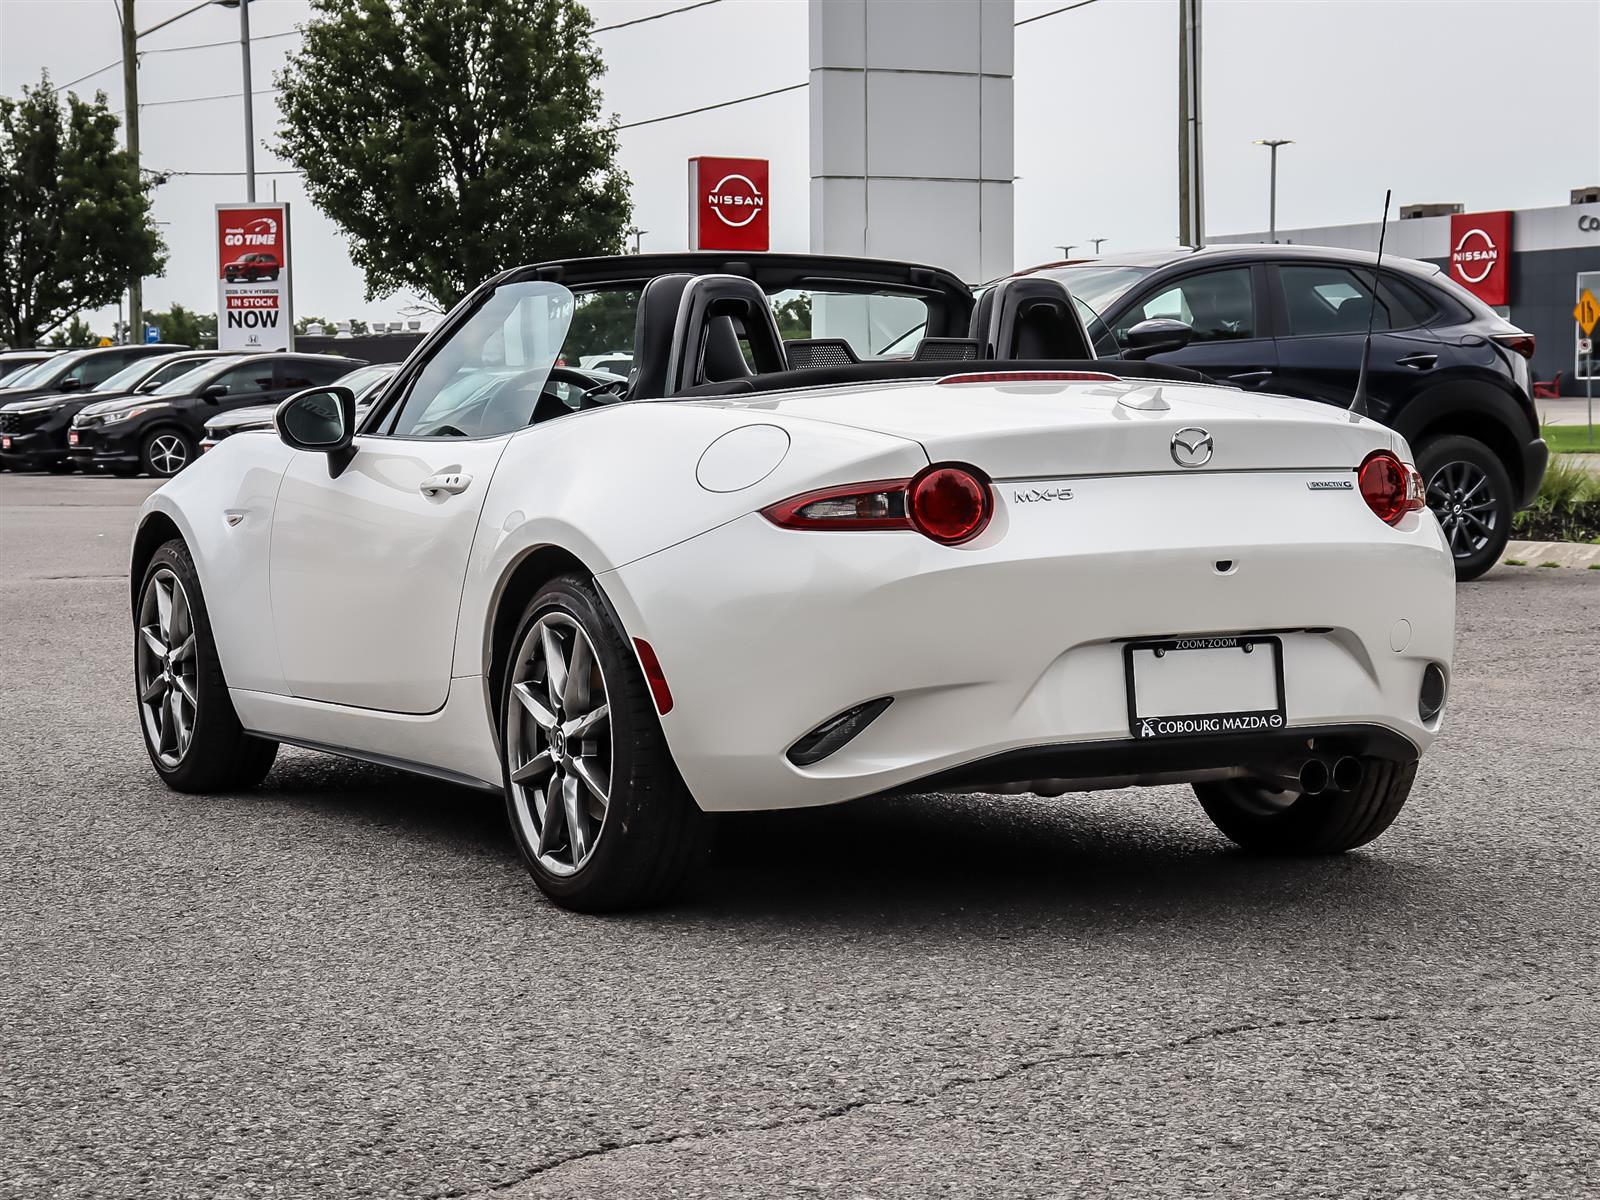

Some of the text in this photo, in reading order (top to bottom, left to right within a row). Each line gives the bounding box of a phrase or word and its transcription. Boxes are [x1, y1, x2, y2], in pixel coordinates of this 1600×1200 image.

[708, 195, 763, 205] NISSAN
[225, 234, 276, 246] GO TIME
[1453, 250, 1498, 261] NISSAN
[231, 298, 274, 306] IN STOCK
[227, 310, 279, 328] NOW
[1013, 488, 1073, 503] MX-5
[1175, 638, 1237, 650] ZOOM-ZOOM
[1157, 716, 1268, 734] COBOURG MAZDA
